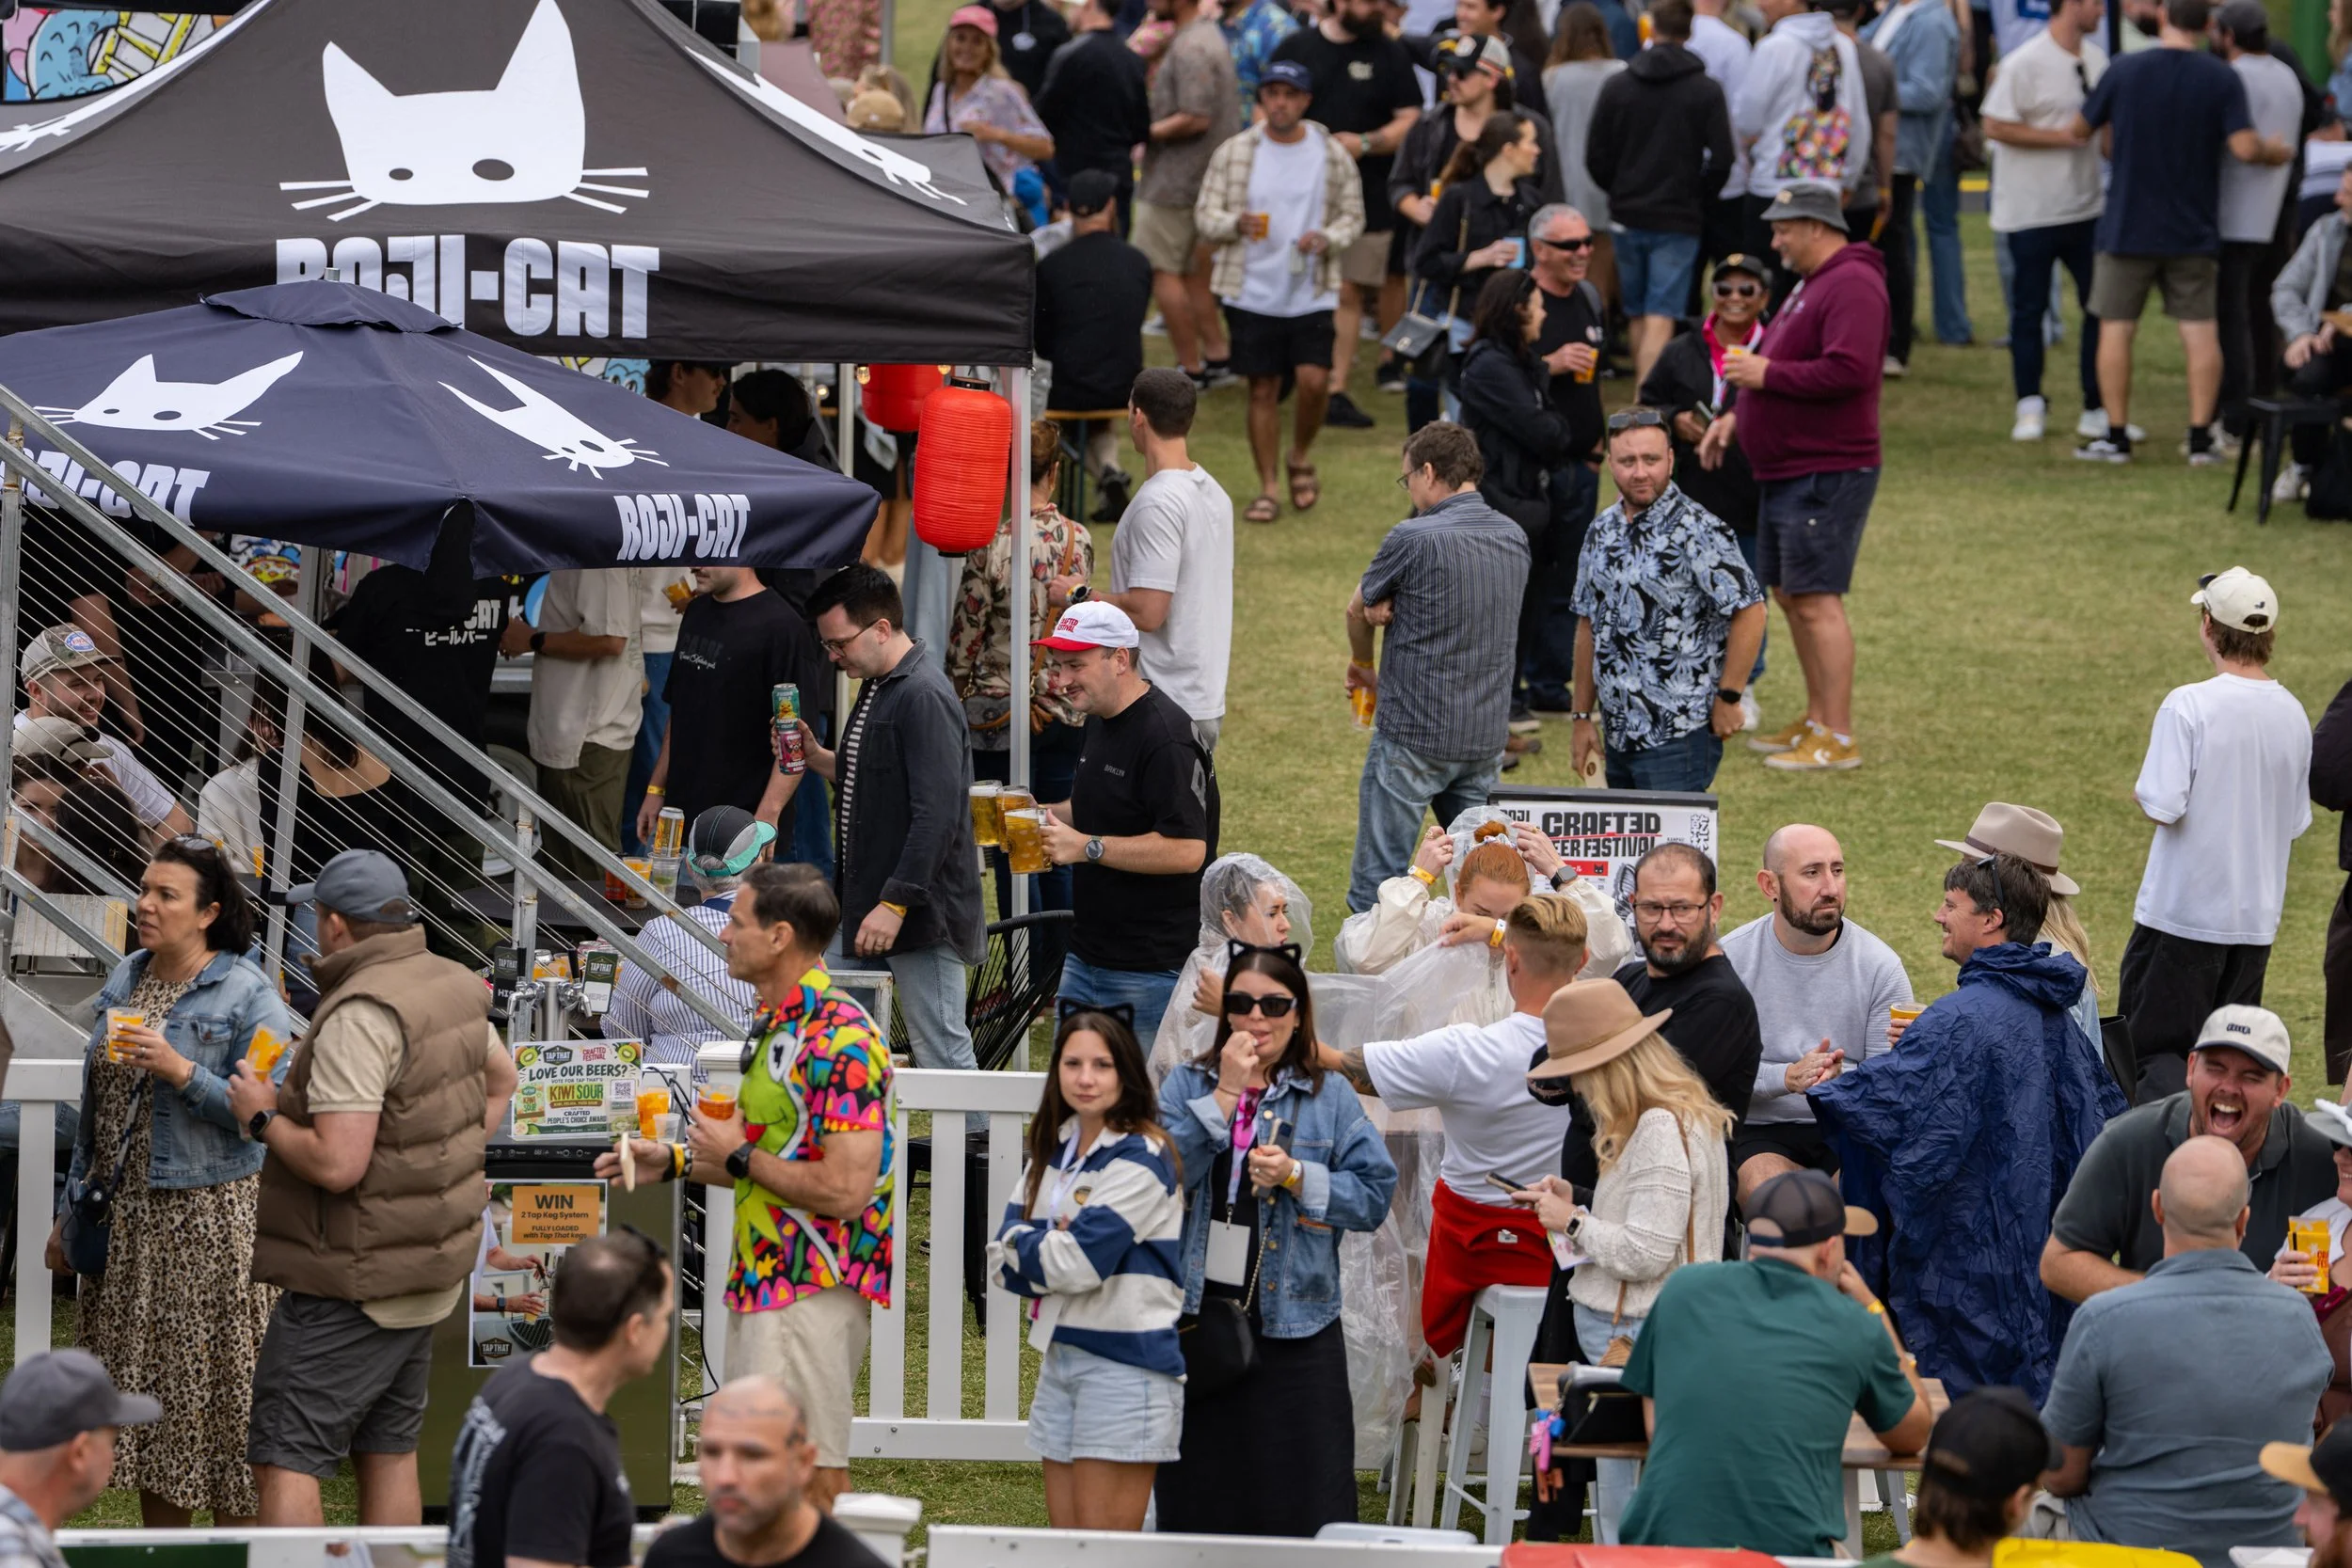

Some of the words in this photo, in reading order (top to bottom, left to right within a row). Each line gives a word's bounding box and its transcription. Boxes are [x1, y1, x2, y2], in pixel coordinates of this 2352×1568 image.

[613, 494, 751, 561] ROJI-CAT
[425, 629, 487, 646] ビールバー
[1553, 839, 1581, 858] EER
[590, 962, 600, 972] TAP
[600, 963, 612, 973] THAT
[546, 1053, 556, 1061] TAP
[556, 1053, 570, 1061] THAT
[582, 1047, 607, 1055] CRAFTED
[582, 1053, 607, 1062] FESTIVAL
[529, 1067, 558, 1082] LOVE
[560, 1065, 584, 1077] OUR
[586, 1064, 628, 1077] BEERS?
[549, 1085, 575, 1101] KIWI
[577, 1084, 604, 1100] SOUR
[534, 1195, 574, 1210] WIN
[528, 1212, 543, 1220] Tap
[544, 1212, 558, 1220] Keg
[482, 1343, 494, 1352] TAP
[494, 1343, 510, 1352] THAT
